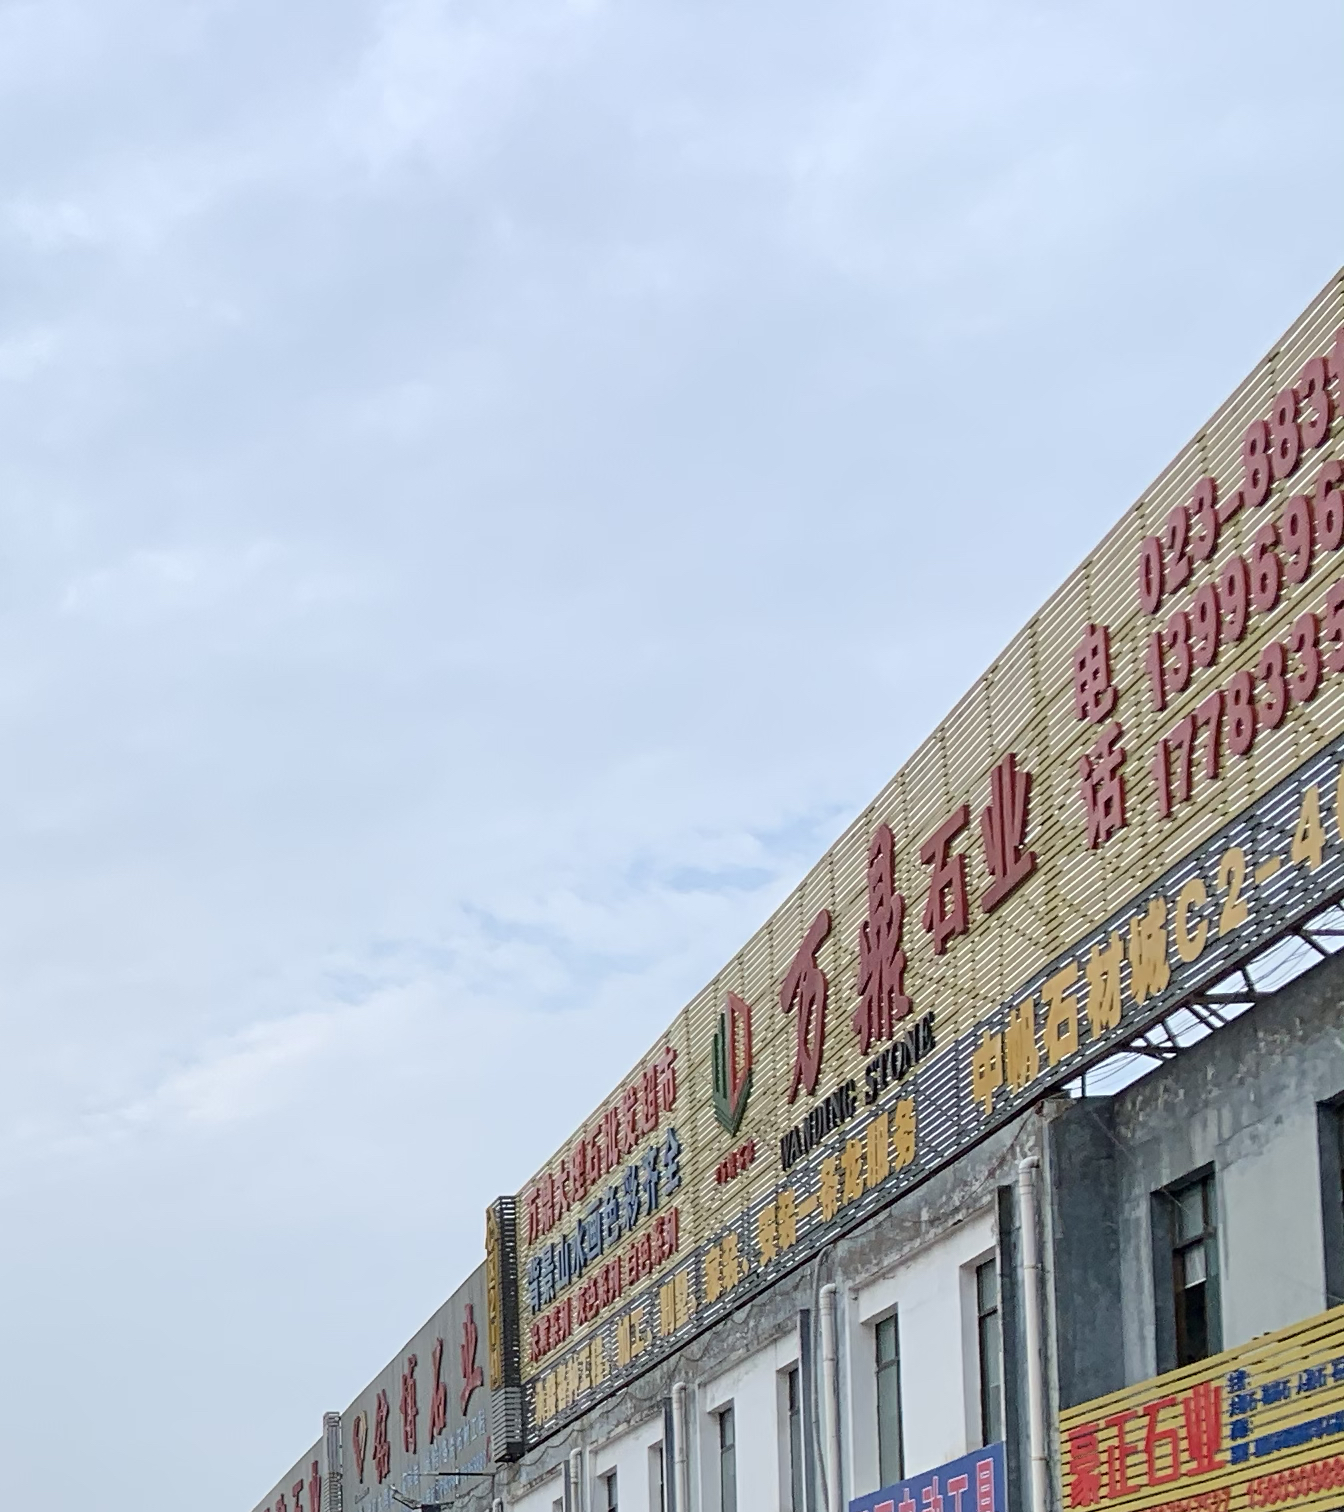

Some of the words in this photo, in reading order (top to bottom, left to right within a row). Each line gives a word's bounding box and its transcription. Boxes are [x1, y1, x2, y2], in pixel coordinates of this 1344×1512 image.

[1075, 624, 1127, 850] 电话
[972, 766, 1344, 1115] 中帆石材城C2-4
[1068, 1380, 1227, 1509] 豪正石业
